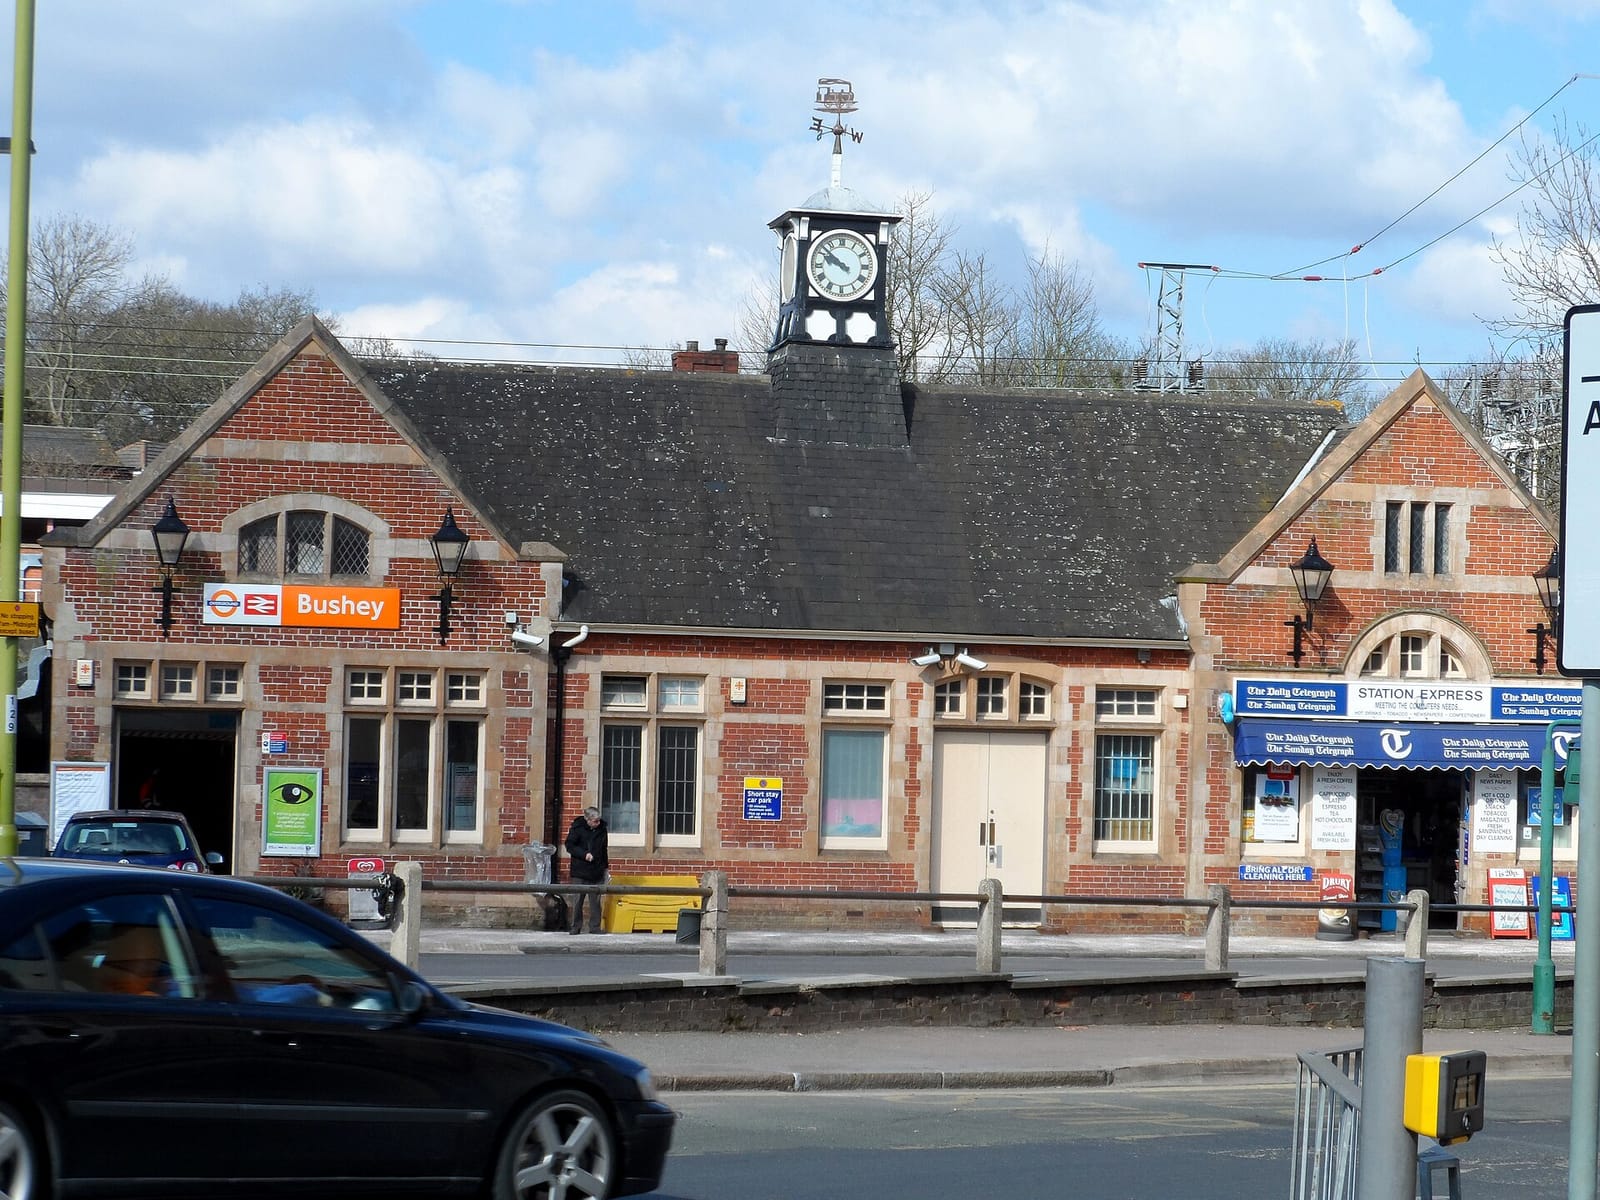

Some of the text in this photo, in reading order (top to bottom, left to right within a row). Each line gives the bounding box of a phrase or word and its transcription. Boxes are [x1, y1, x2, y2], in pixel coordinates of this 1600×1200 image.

[298, 594, 384, 621] Bushey
[1248, 686, 1336, 699] The Daily Telegraph
[1358, 688, 1483, 700] STATION EXPRESS
[1502, 693, 1582, 704] The Daily Telegrap
[1248, 701, 1336, 712] The Sunday Telegraph
[1502, 707, 1582, 717] The Sunday Telegrap
[1266, 732, 1354, 746] The Daily Telegraph
[1442, 738, 1528, 749] The Daily Telegraph
[1267, 744, 1354, 757] The Sunday Telegraph
[1444, 750, 1530, 760] The Sunday Telegraph
[1322, 877, 1352, 892] DRURY
